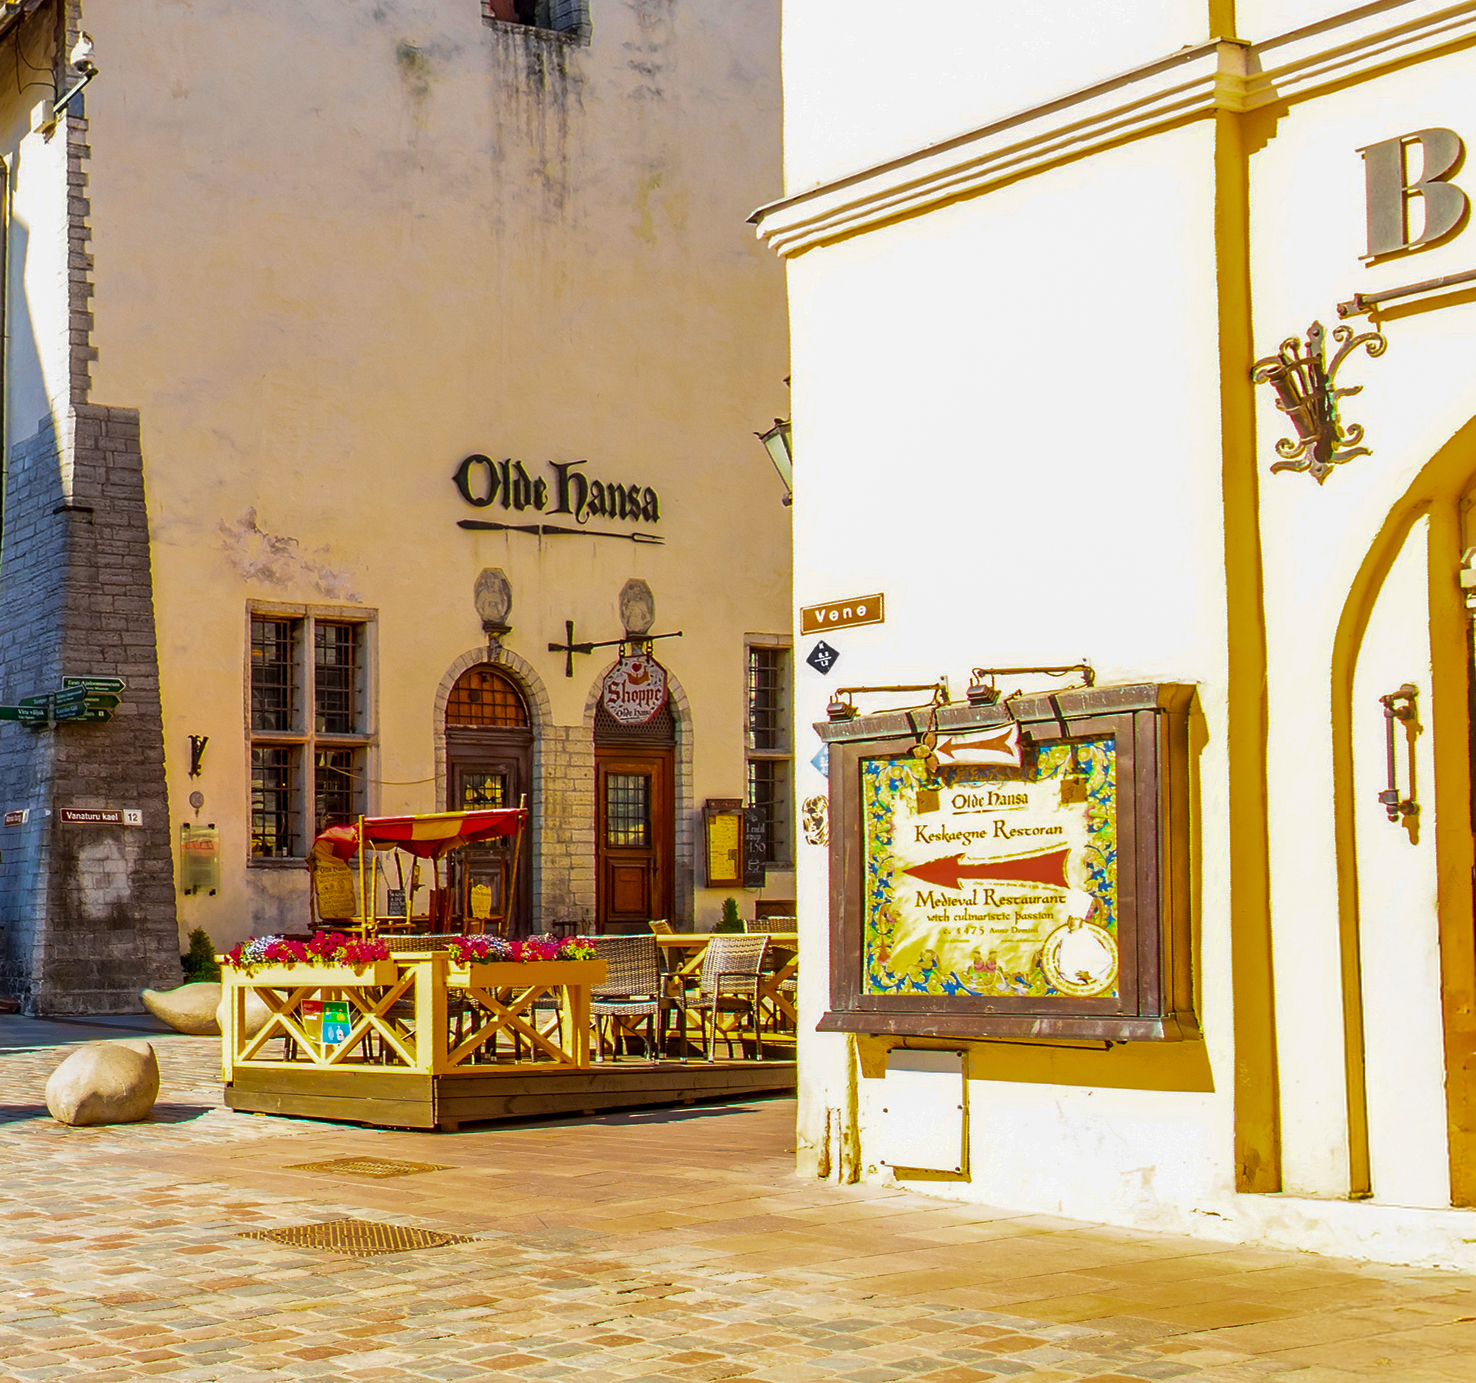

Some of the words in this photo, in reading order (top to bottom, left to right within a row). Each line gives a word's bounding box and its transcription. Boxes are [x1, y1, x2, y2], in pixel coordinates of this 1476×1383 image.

[451, 453, 548, 511] Olde
[545, 459, 661, 524] Hansa
[814, 604, 867, 623] Vene
[606, 679, 661, 707] Shoppe
[951, 793, 985, 809] Olde
[987, 790, 1029, 806] Hansa
[66, 811, 101, 821] Vanaturu
[102, 812, 119, 821] kael
[127, 813, 138, 822] 12
[914, 823, 988, 846] Keskaegne
[992, 819, 1063, 839] Restoran
[914, 888, 978, 909] Medieval
[983, 888, 1067, 908] Restaurant
[926, 908, 950, 922] with
[953, 908, 1011, 921] culinaristic
[1014, 911, 1054, 925] passion
[956, 925, 985, 935] 1475
[989, 926, 1009, 934] Anno
[1011, 926, 1039, 934] Domini
